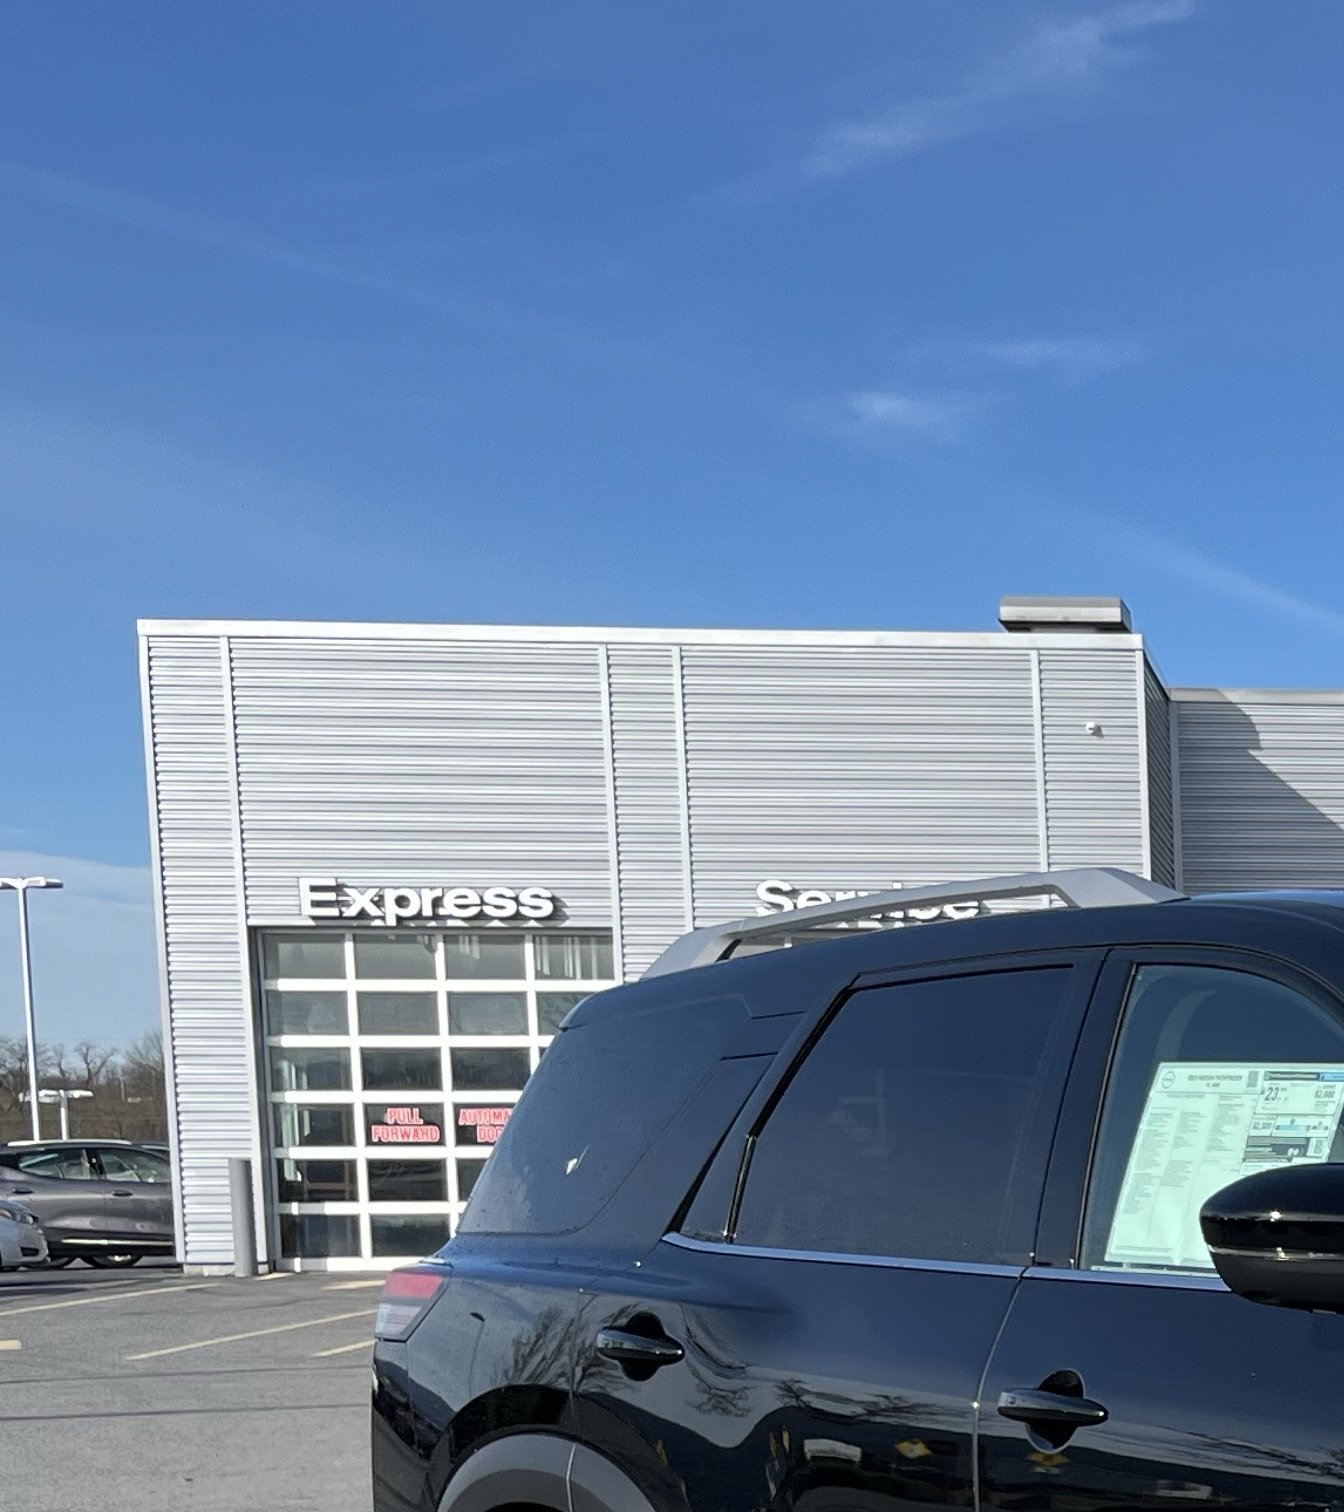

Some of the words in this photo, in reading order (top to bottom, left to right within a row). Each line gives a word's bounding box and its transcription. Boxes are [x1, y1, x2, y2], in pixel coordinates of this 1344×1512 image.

[299, 877, 554, 926] Express
[387, 1107, 423, 1124] PULL
[371, 1125, 440, 1142] FORWARD
